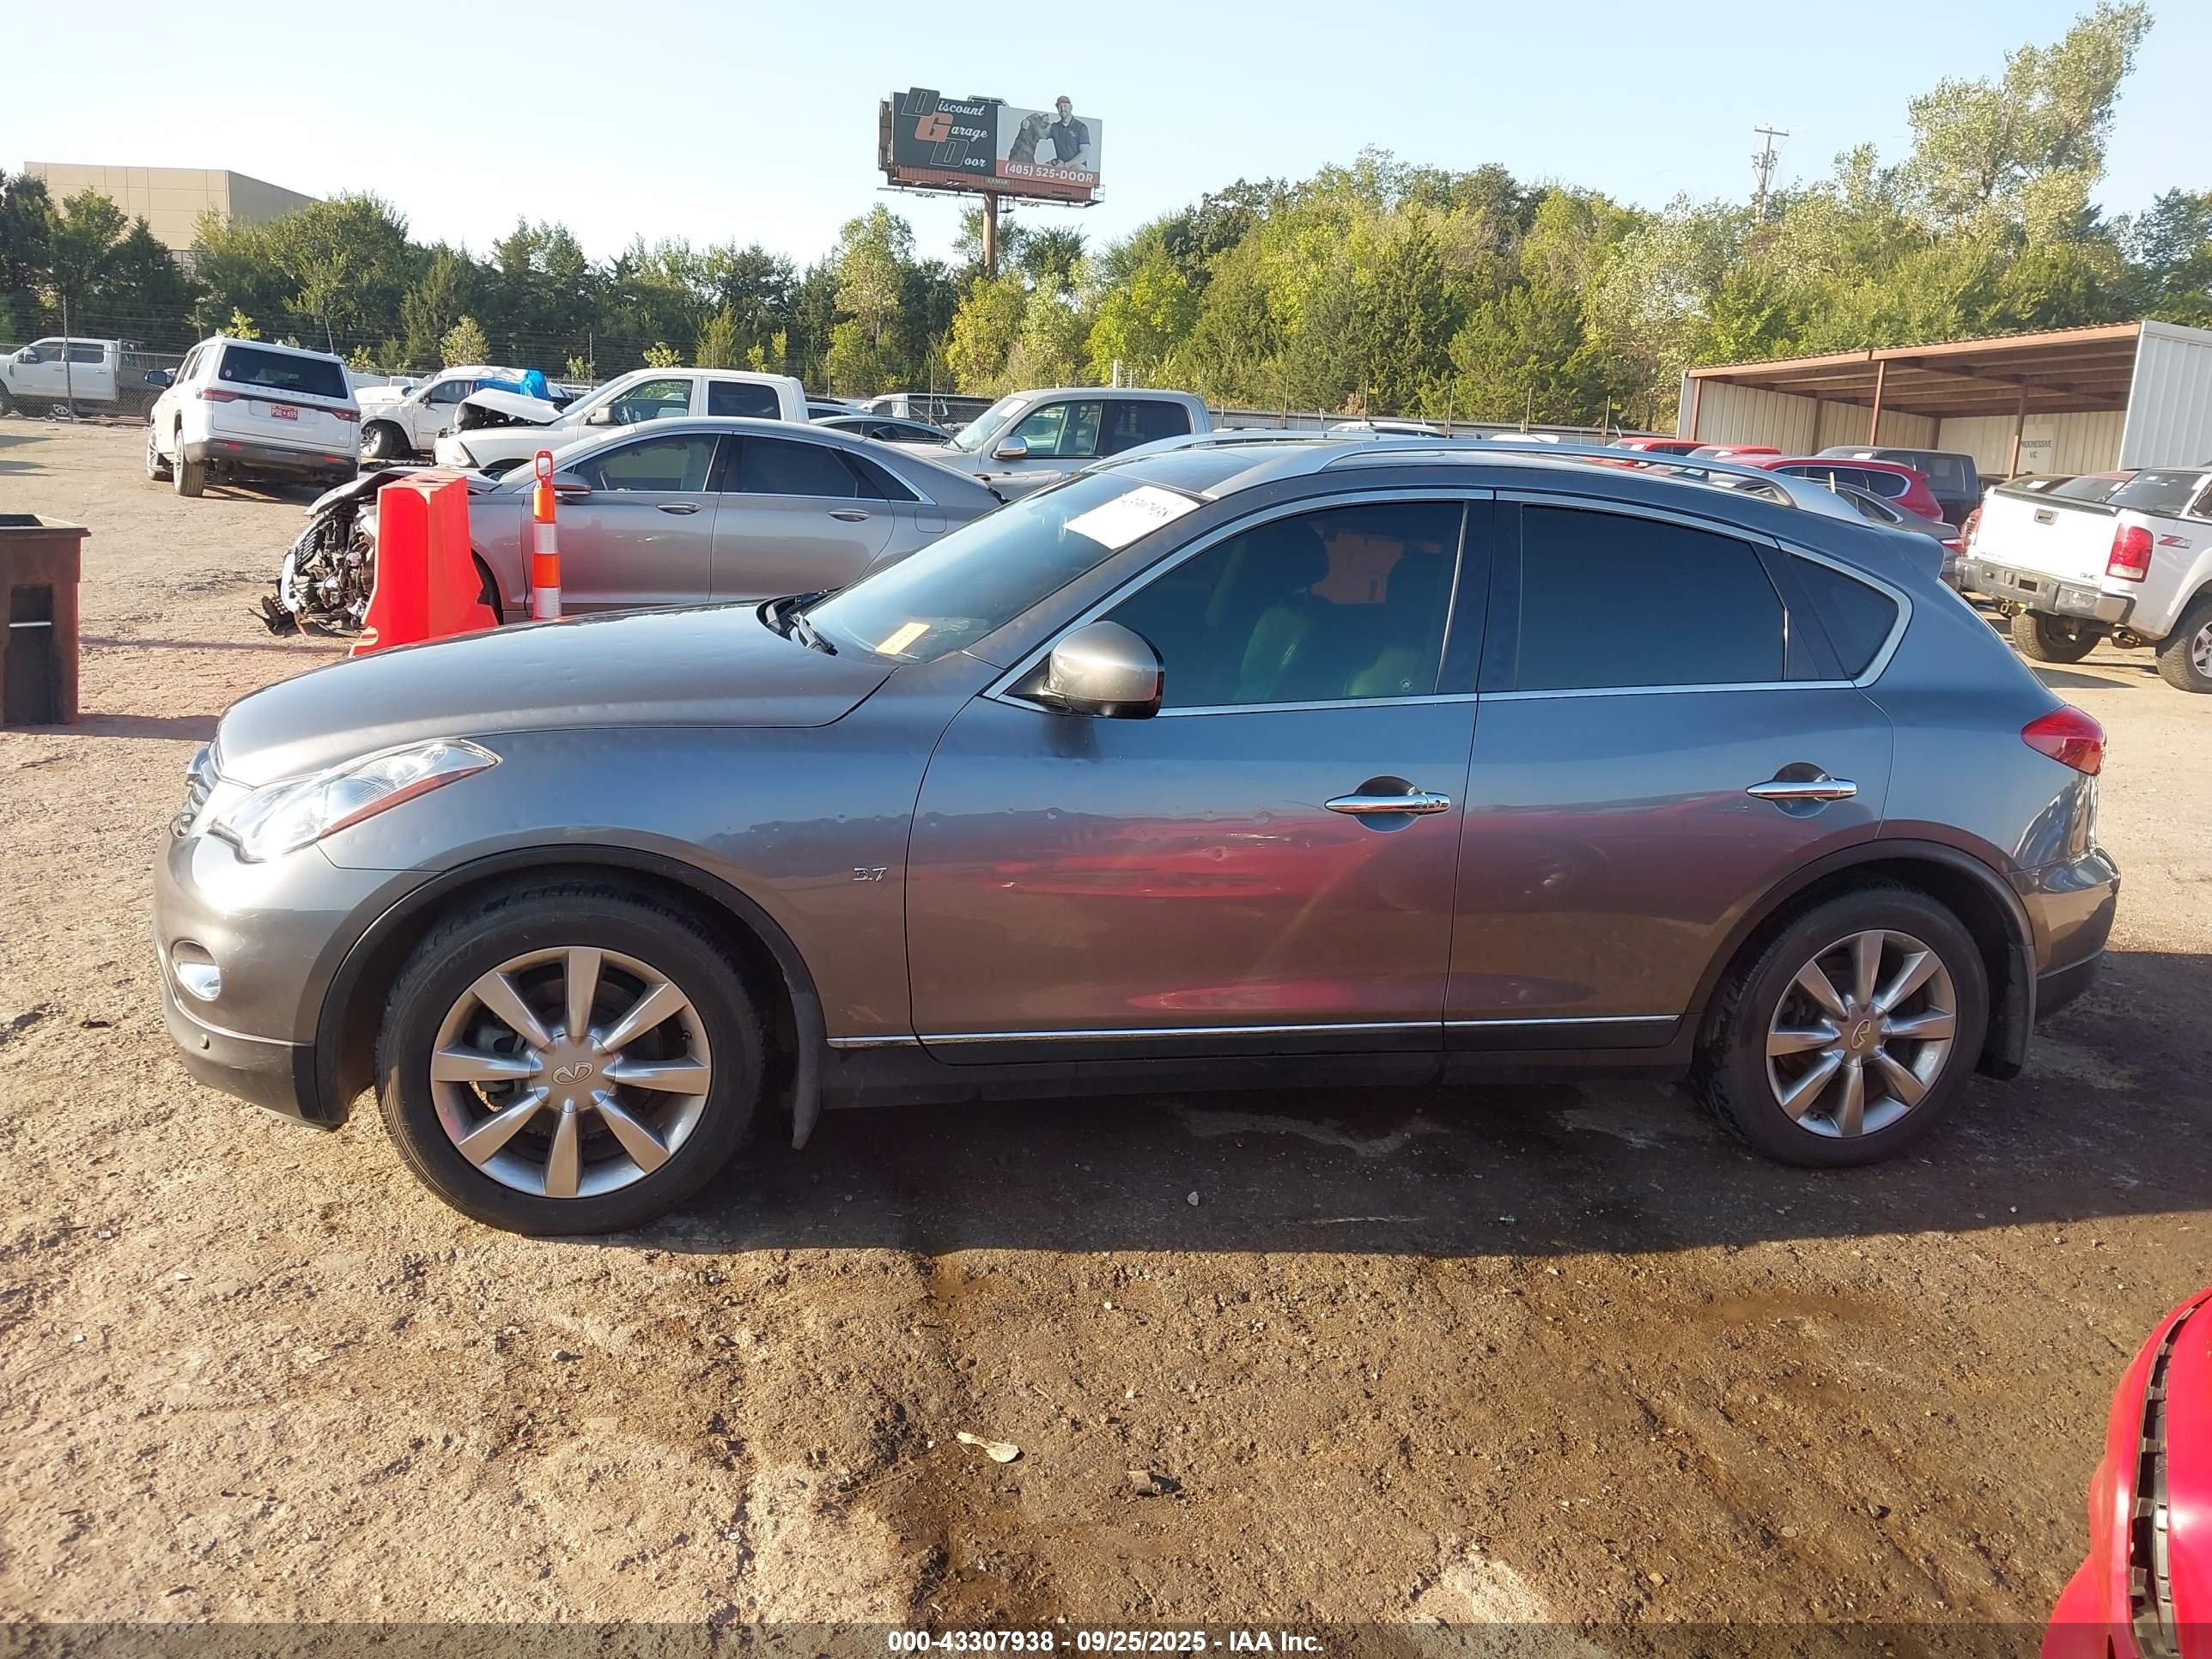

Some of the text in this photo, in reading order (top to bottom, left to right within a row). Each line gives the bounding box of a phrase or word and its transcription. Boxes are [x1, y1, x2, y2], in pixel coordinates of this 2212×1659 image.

[901, 87, 986, 118] Discount
[915, 112, 988, 143] Garage
[930, 137, 987, 167] Door
[1005, 162, 1093, 183] (405) 525-DOOR
[854, 867, 887, 882] 3.7
